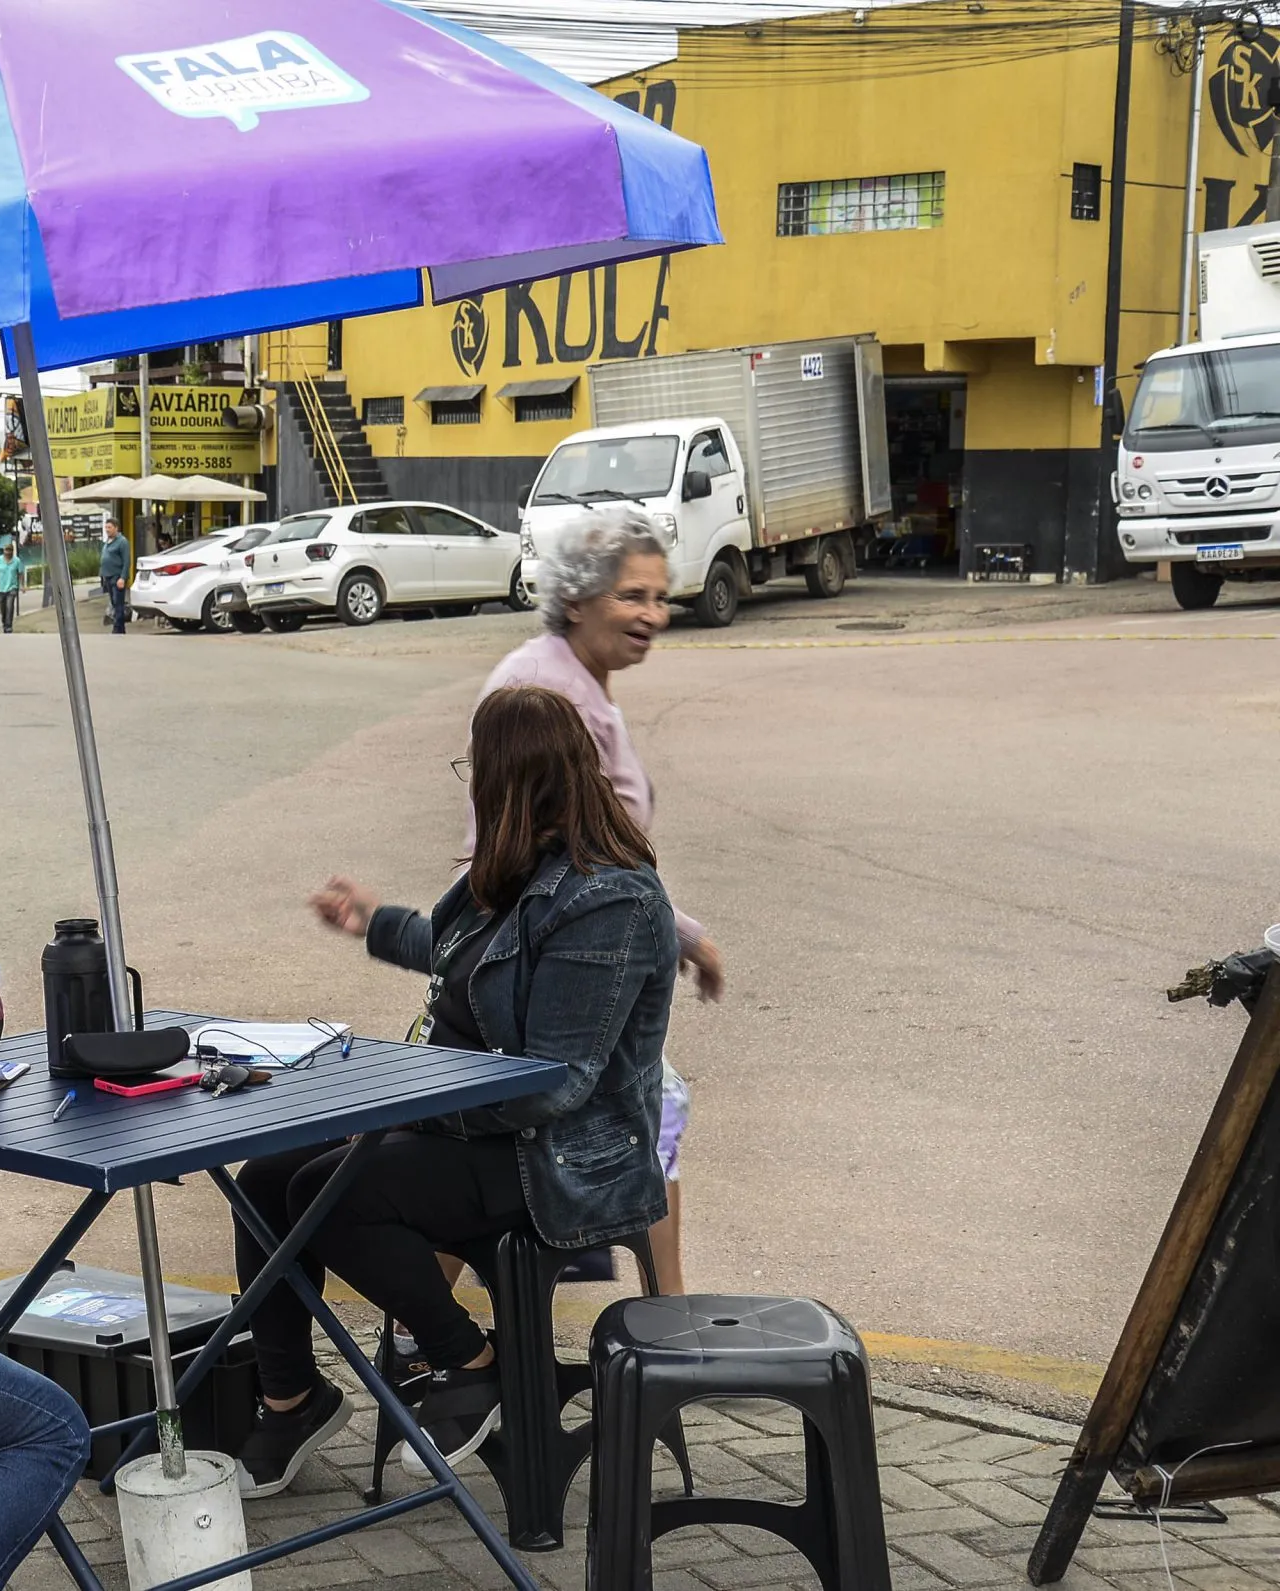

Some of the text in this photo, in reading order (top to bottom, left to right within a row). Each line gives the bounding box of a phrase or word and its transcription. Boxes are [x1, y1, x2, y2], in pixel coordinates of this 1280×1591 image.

[131, 39, 309, 85] FALA
[165, 70, 334, 100] CURITIBA
[803, 356, 822, 377] 4422
[149, 388, 230, 413] AVIÁRIO
[149, 416, 177, 427] GUIA
